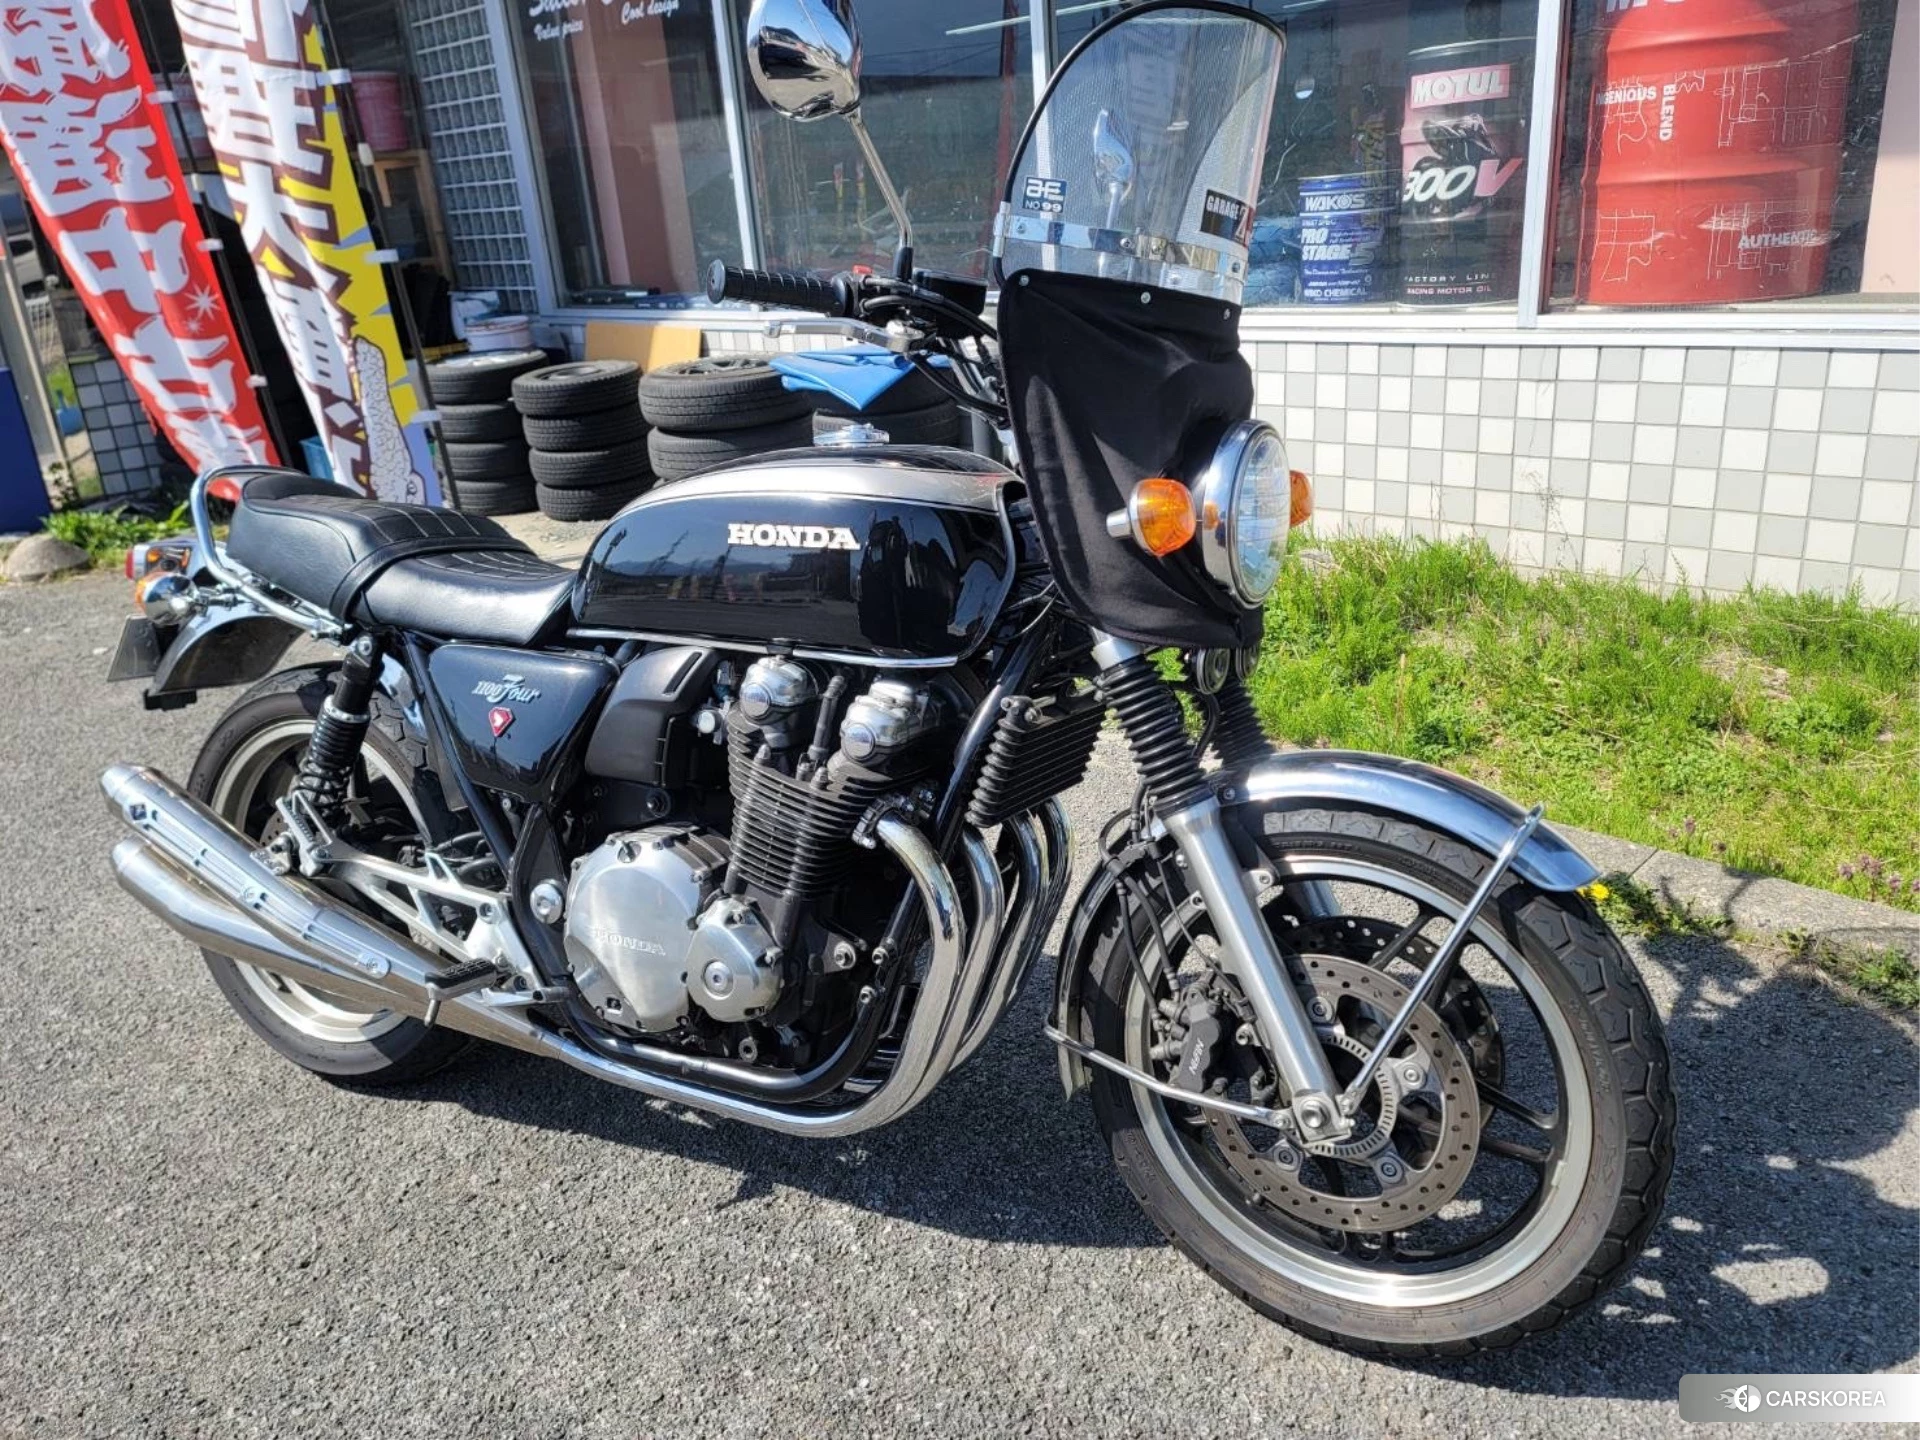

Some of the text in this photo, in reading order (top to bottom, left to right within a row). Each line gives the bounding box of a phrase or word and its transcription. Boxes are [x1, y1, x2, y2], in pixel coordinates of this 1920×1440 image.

[1413, 70, 1504, 103] MOTUL
[1659, 83, 1676, 141] BLEND
[1402, 157, 1523, 202] 300V
[1206, 194, 1240, 221] GARAGE
[1301, 228, 1329, 244] PRO
[1324, 287, 1368, 297] CHEMICAL
[1437, 287, 1472, 295] MOTOR
[728, 523, 861, 550] HONDA
